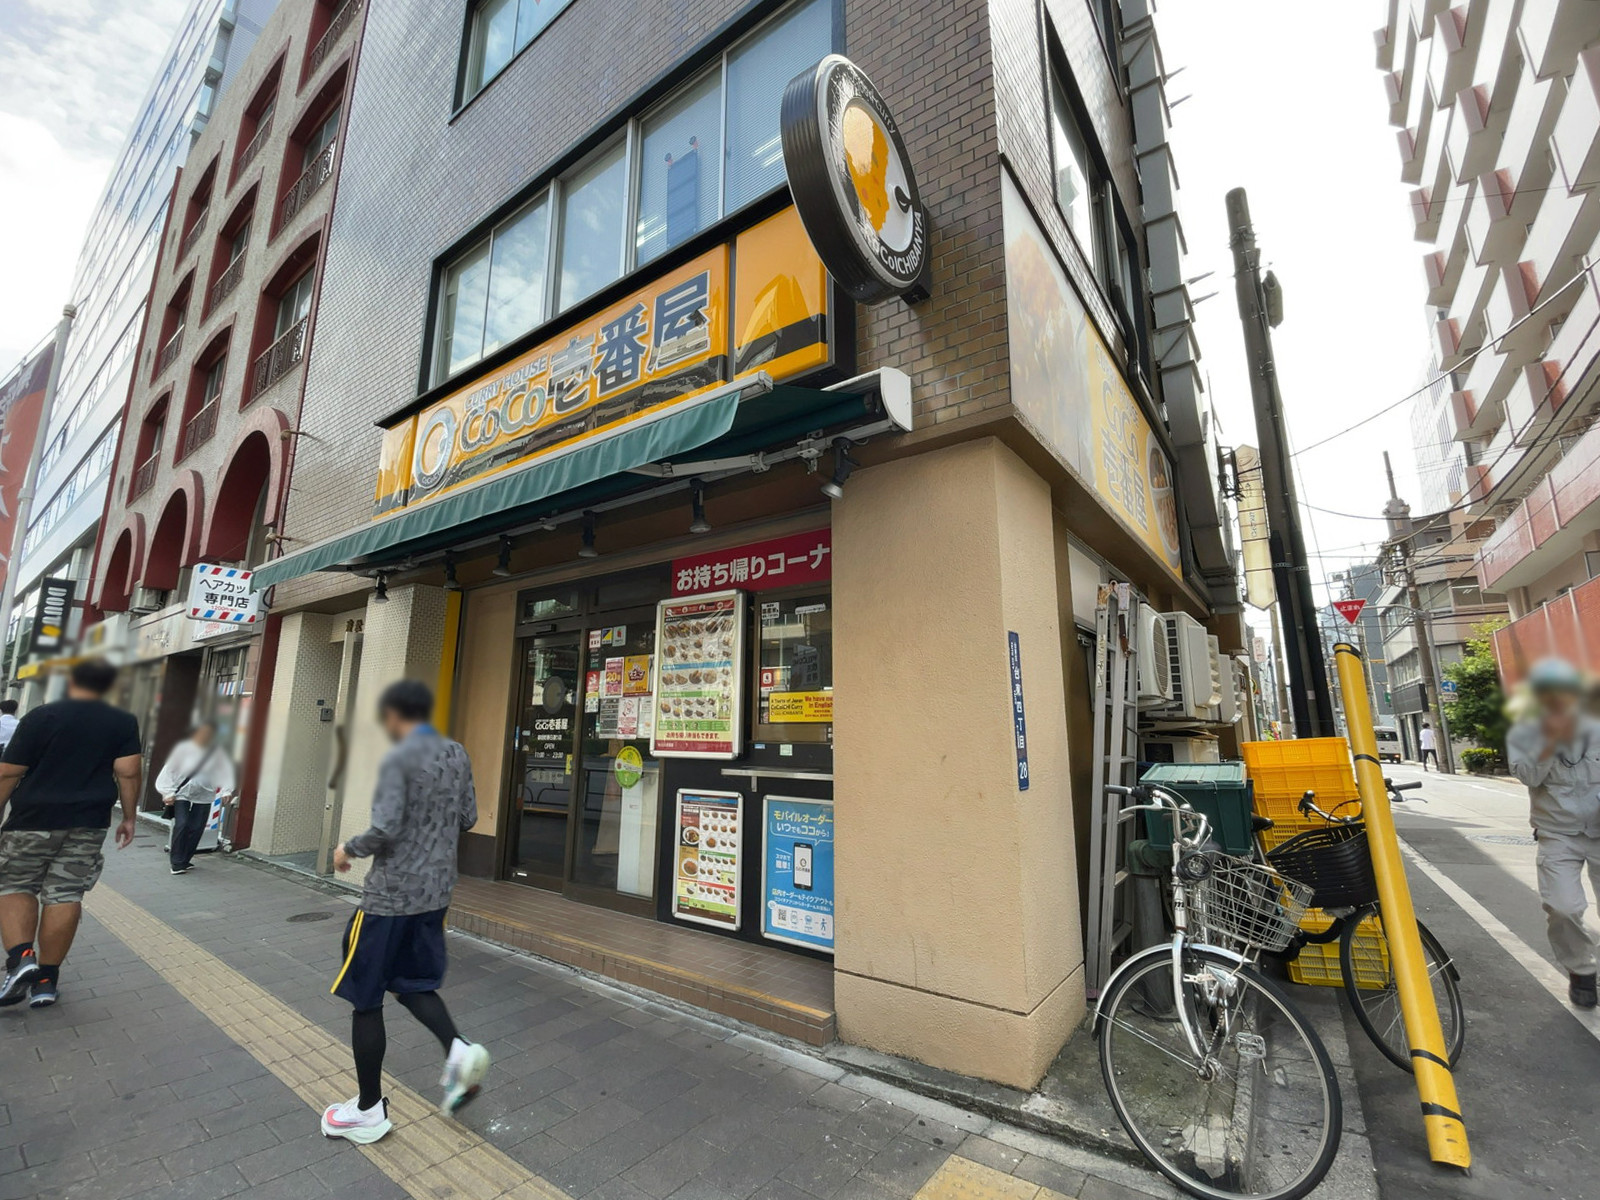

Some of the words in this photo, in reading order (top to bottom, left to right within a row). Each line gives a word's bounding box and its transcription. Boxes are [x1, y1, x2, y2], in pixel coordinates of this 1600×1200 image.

[465, 380, 501, 412] CURRY
[502, 353, 548, 393] HOUSE
[676, 543, 831, 591] お持ち帰りコーナ
[199, 578, 257, 595] ヘアカッ
[203, 592, 250, 609] 専門店
[1340, 604, 1361, 612] 止まれ
[1019, 762, 1028, 779] 28
[774, 810, 834, 826] モバイルオーダー
